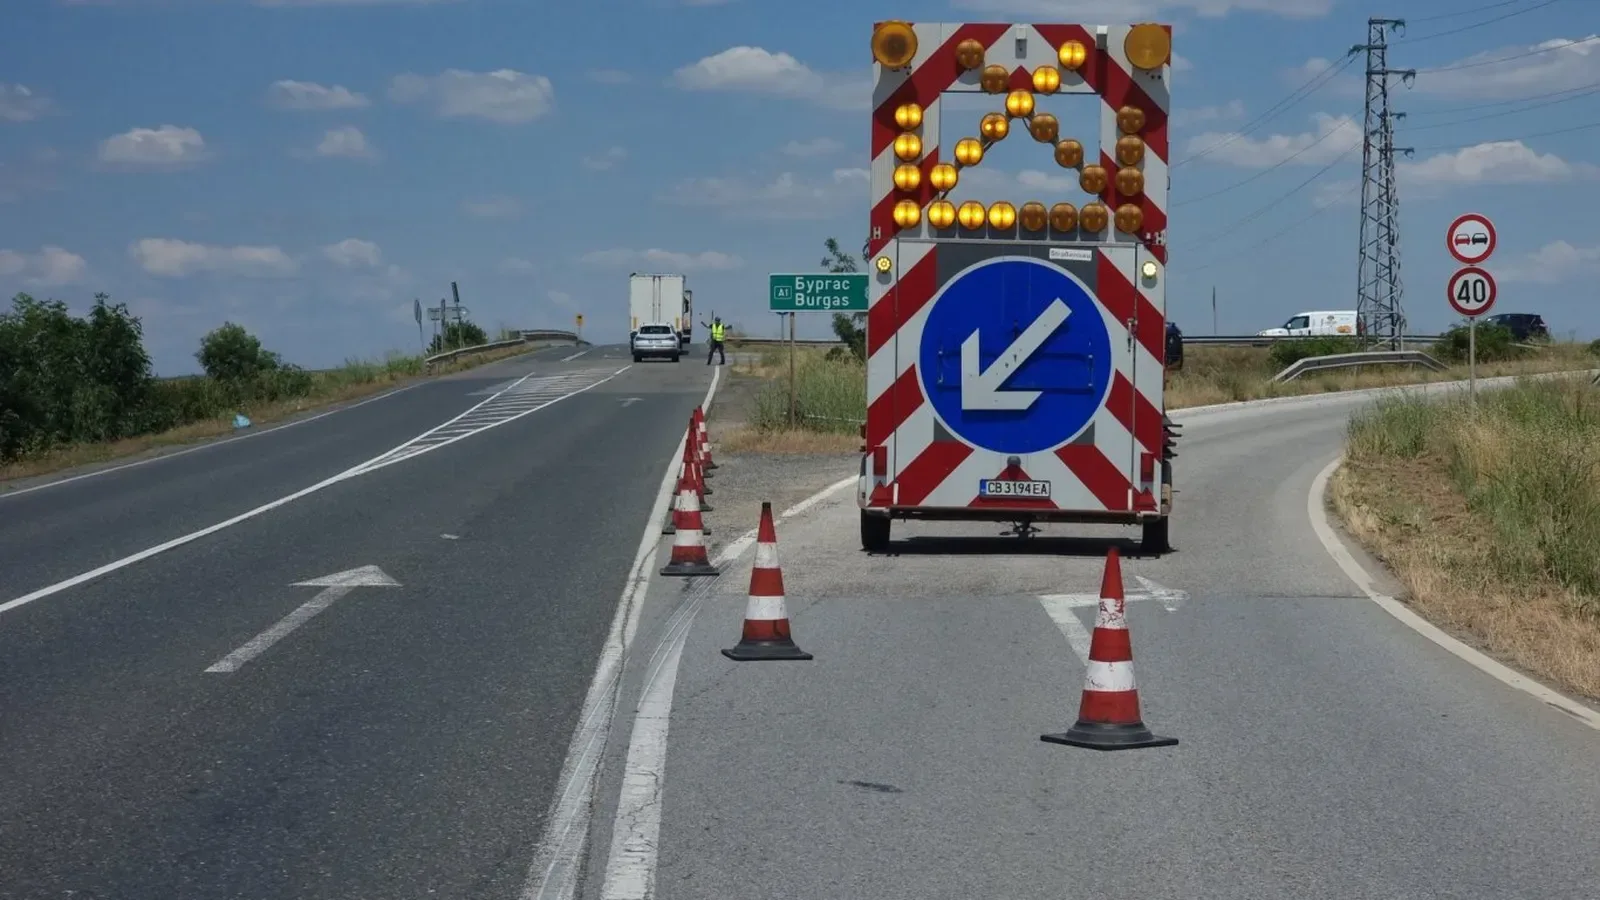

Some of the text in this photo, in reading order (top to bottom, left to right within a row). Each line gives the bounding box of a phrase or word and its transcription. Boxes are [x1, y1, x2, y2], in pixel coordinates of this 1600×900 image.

[778, 288, 788, 297] A1
[795, 276, 850, 293] Бургас
[1457, 279, 1485, 304] 40
[795, 293, 849, 309] Burgas
